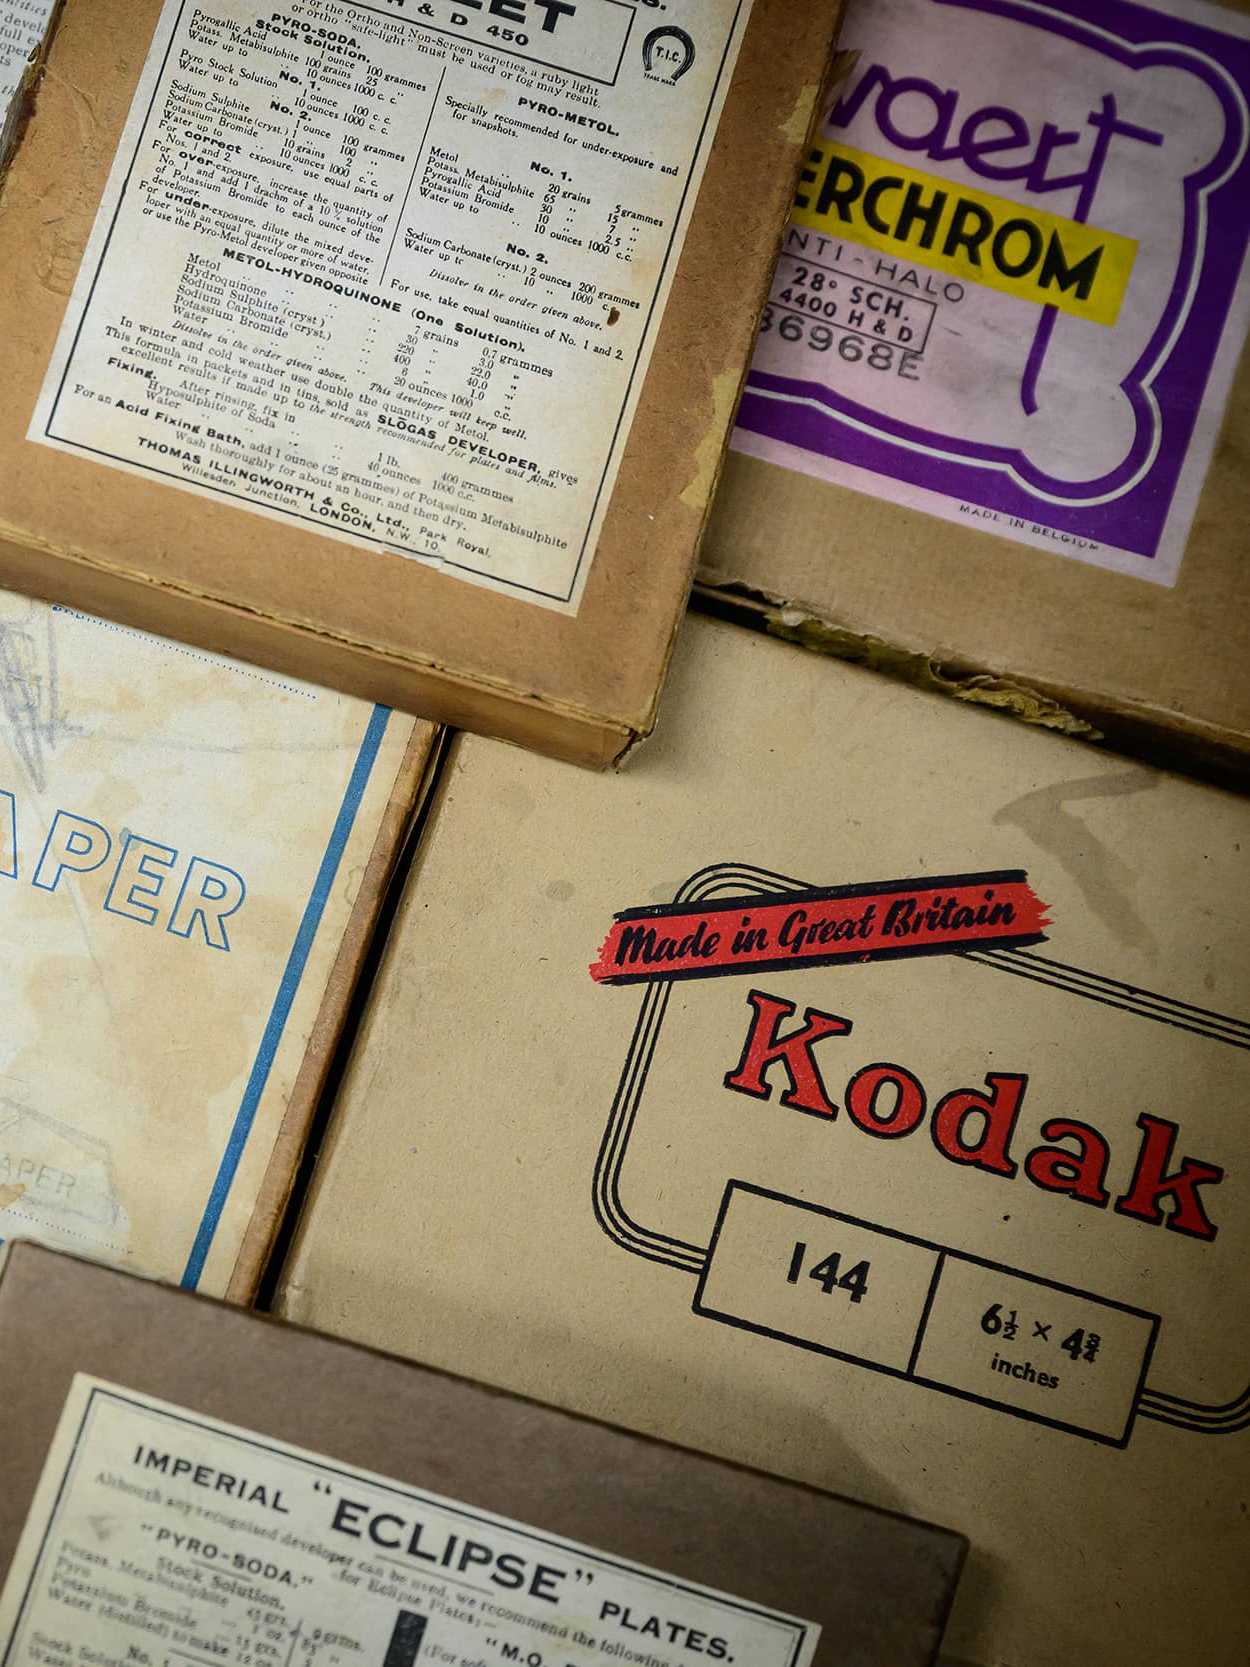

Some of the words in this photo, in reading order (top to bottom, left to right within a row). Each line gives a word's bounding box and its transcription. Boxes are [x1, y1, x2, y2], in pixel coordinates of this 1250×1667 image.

[193, 10, 240, 32] Pyrogallic
[243, 26, 267, 40] Acid
[256, 19, 297, 39] Stock
[304, 35, 369, 62] Solution.
[271, 13, 360, 48] PYRO-SODA.
[485, 24, 530, 48] 450
[445, 96, 487, 117] Specially
[494, 114, 559, 139] recommended
[563, 133, 577, 144] for
[582, 142, 653, 168] under-exposure
[660, 166, 678, 176] and
[452, 109, 467, 120] for
[472, 118, 517, 137] snapshots.
[518, 97, 618, 136] PYRO-METOL.
[223, 248, 401, 312] METOL-HYDROQUINONE
[875, 259, 963, 302] HALO
[779, 288, 838, 318] 4400
[848, 310, 863, 326] H
[898, 326, 911, 341] D
[849, 286, 910, 321] SCH.
[411, 308, 442, 325] (One
[454, 323, 524, 351] Solution).
[107, 357, 156, 379] Fixing.
[115, 400, 148, 416] Acid
[155, 412, 200, 433] Fixing
[206, 428, 244, 448] Bath,
[138, 437, 200, 463] THOMAS
[209, 460, 314, 499] ILLINGWORTH
[322, 497, 331, 505] &
[448, 436, 540, 473] DEVELOPER,
[1009, 518, 1024, 528] IN
[614, 923, 722, 967] Made
[731, 923, 769, 950] in
[778, 907, 877, 951] Great
[884, 889, 1016, 936] Britain
[724, 988, 1224, 1241] Kodak
[787, 1242, 871, 1304] 144
[990, 1352, 1060, 1391] inches
[134, 1446, 288, 1513] IMPERIAL
[599, 1601, 733, 1663] PLATES.
